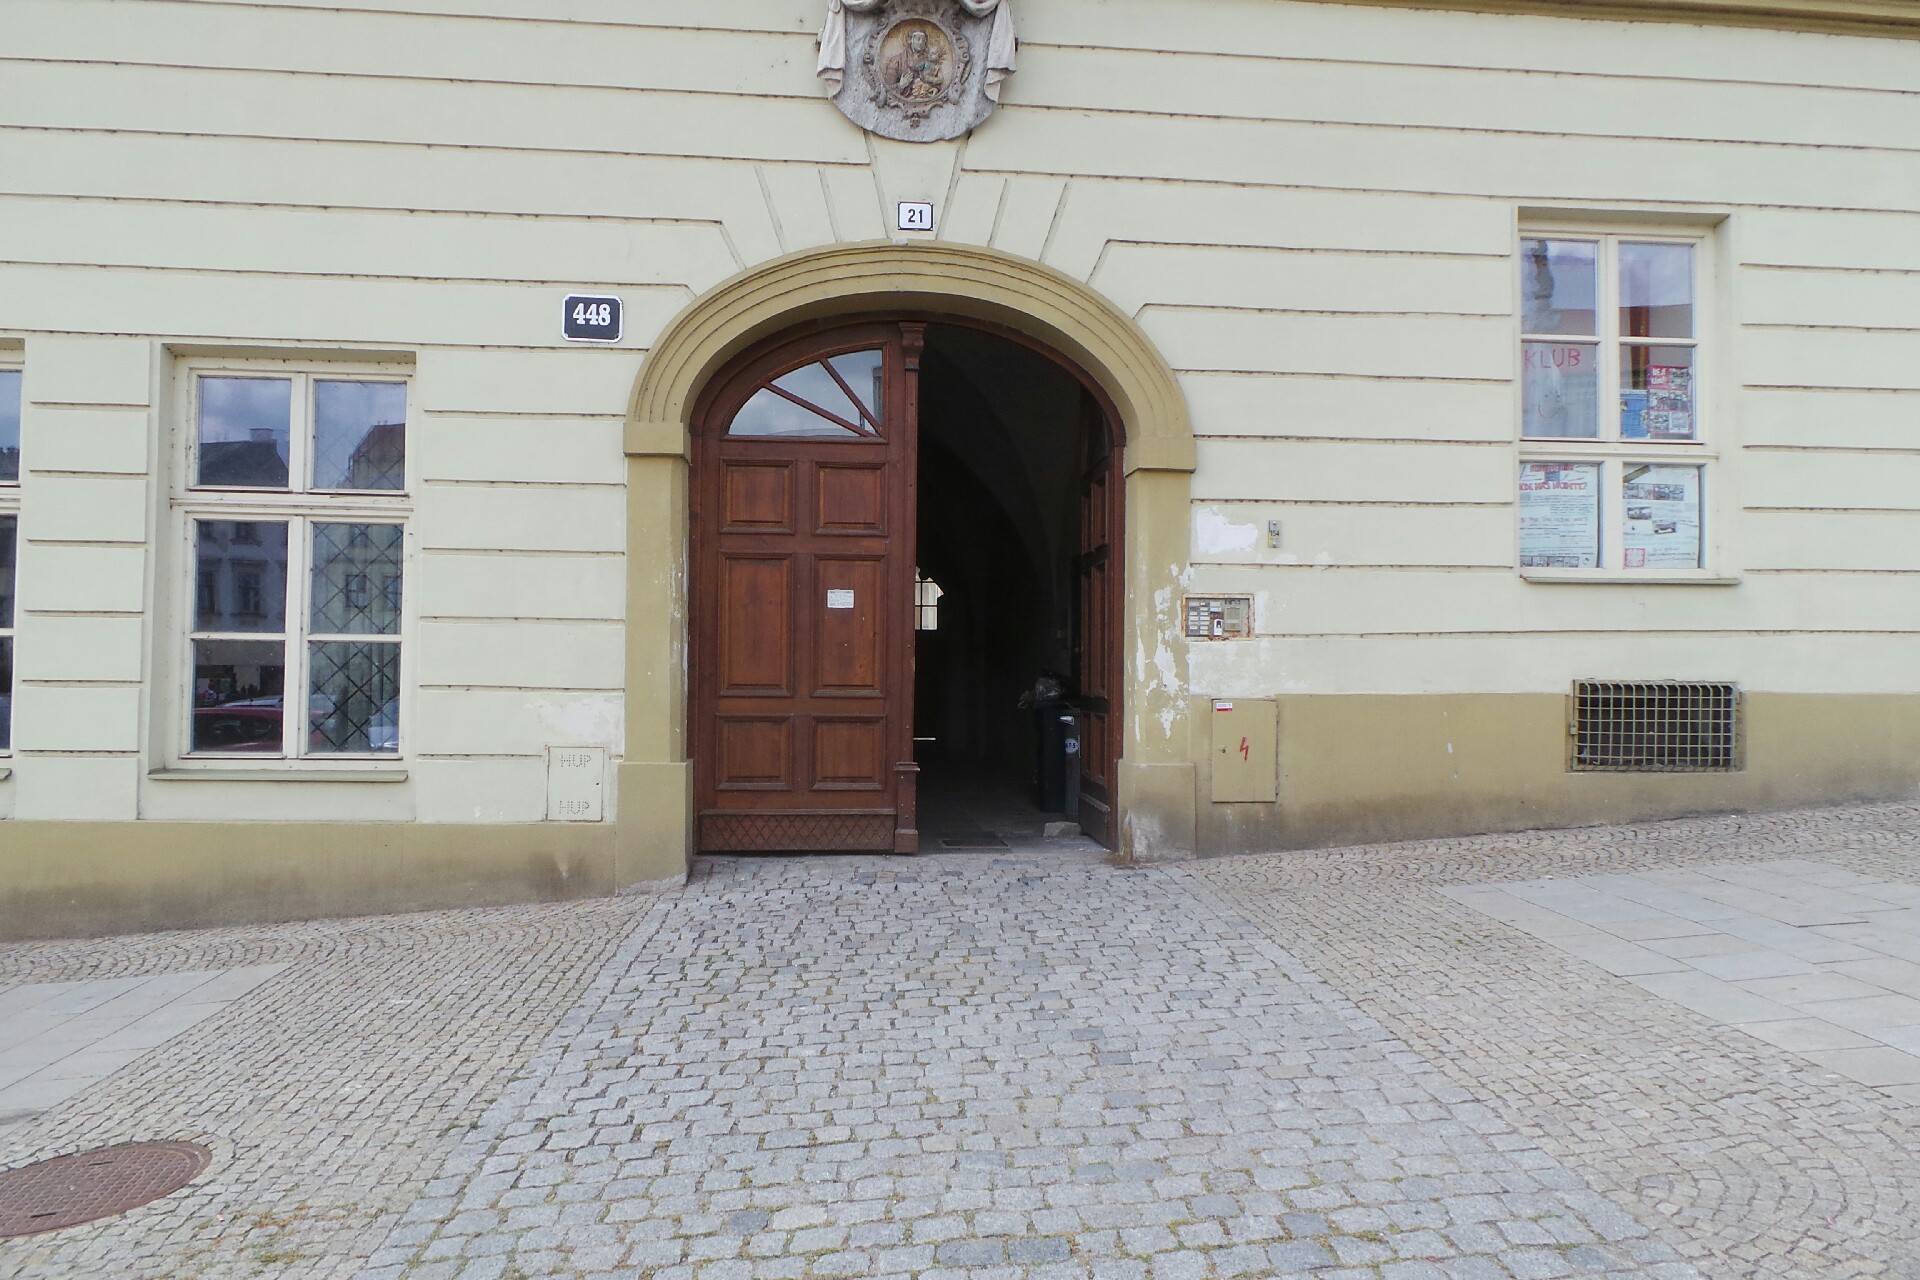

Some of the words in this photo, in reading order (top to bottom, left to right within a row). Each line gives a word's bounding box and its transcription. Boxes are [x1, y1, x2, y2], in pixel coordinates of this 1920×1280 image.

[908, 208, 923, 224] 21
[572, 302, 611, 326] 448
[1524, 347, 1581, 369] KLUB
[560, 754, 592, 768] HUP
[559, 800, 590, 815] HUP
